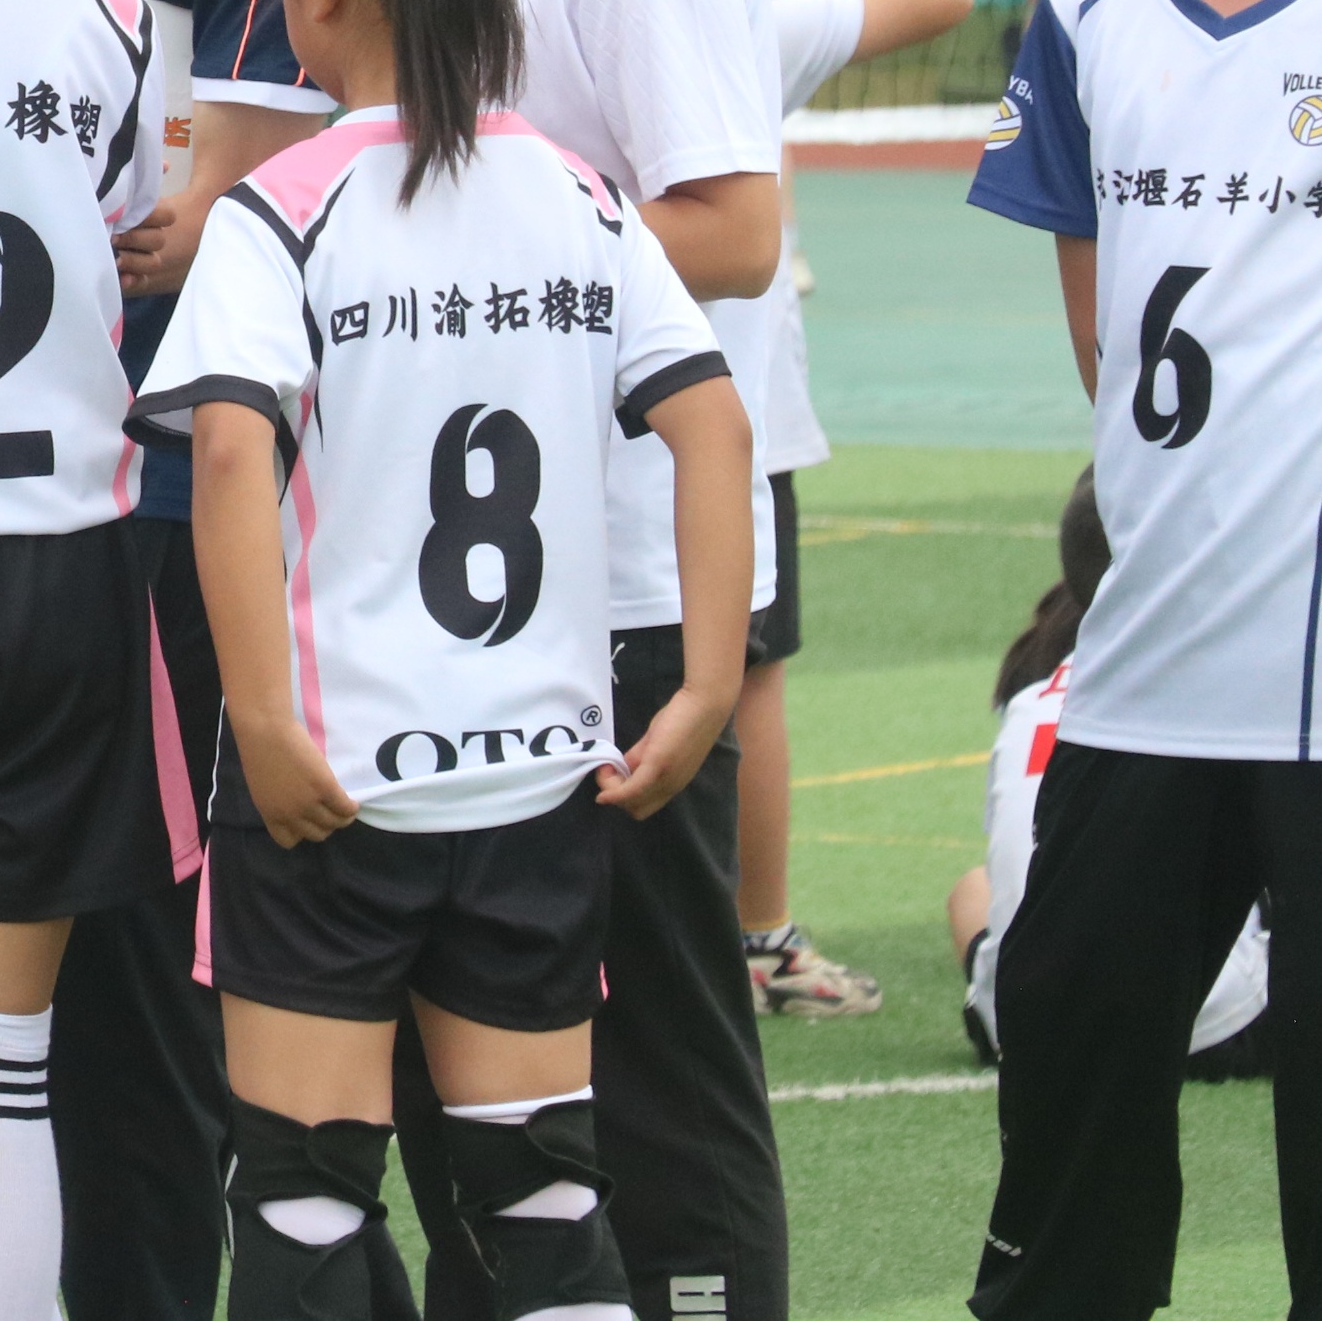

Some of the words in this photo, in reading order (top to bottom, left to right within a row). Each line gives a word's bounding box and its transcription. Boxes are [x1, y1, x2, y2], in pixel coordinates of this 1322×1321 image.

[1096, 167, 1322, 218] 江堰石羊小学
[331, 277, 614, 345] 四川渝拓橡塑
[1133, 265, 1211, 450] 6
[419, 404, 543, 646] 8
